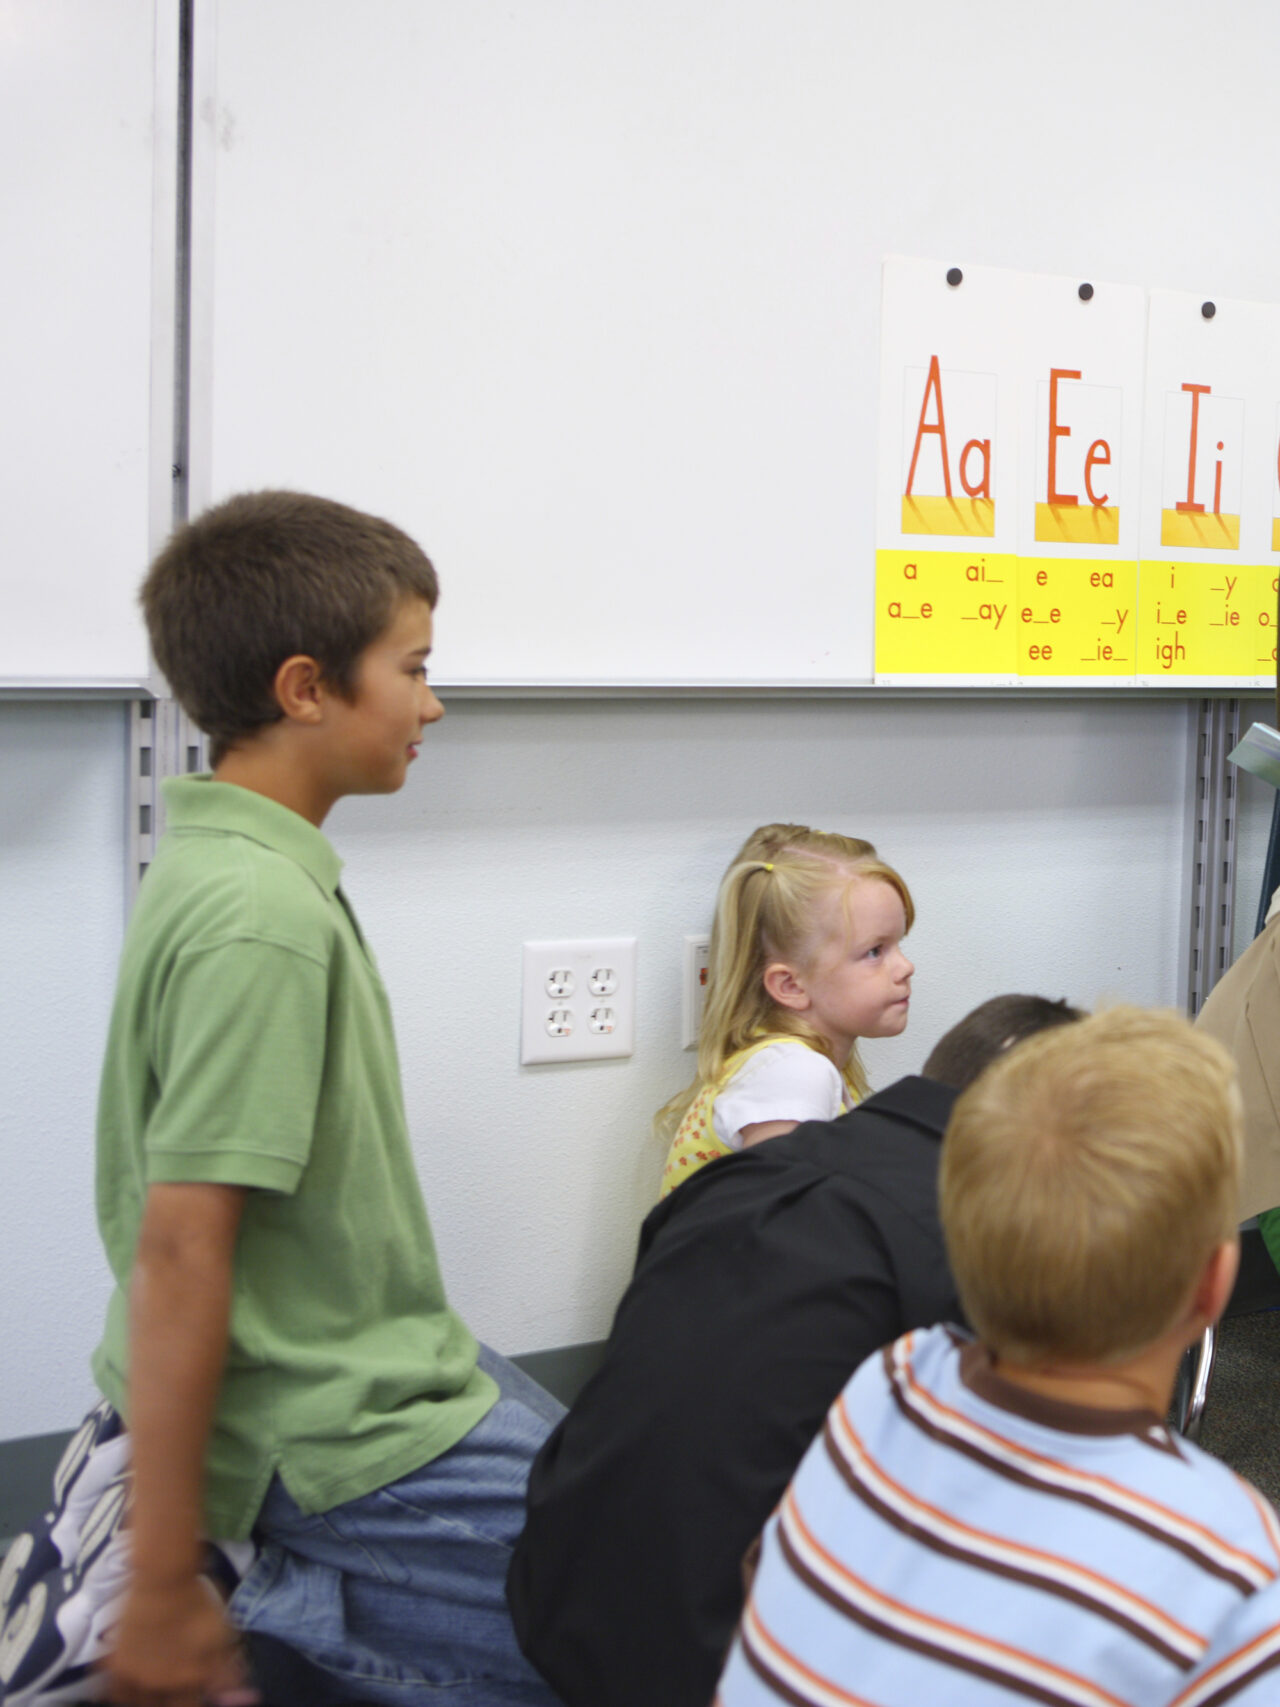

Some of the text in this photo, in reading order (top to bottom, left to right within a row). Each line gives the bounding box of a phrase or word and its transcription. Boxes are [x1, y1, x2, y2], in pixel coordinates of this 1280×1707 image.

[905, 354, 991, 499] Aa
[1047, 367, 1112, 507] Ee
[903, 562, 917, 580] a
[1036, 570, 1113, 588] e ea
[1171, 566, 1176, 587] i
[1028, 644, 1053, 661] ee
[1156, 631, 1185, 669] igh
